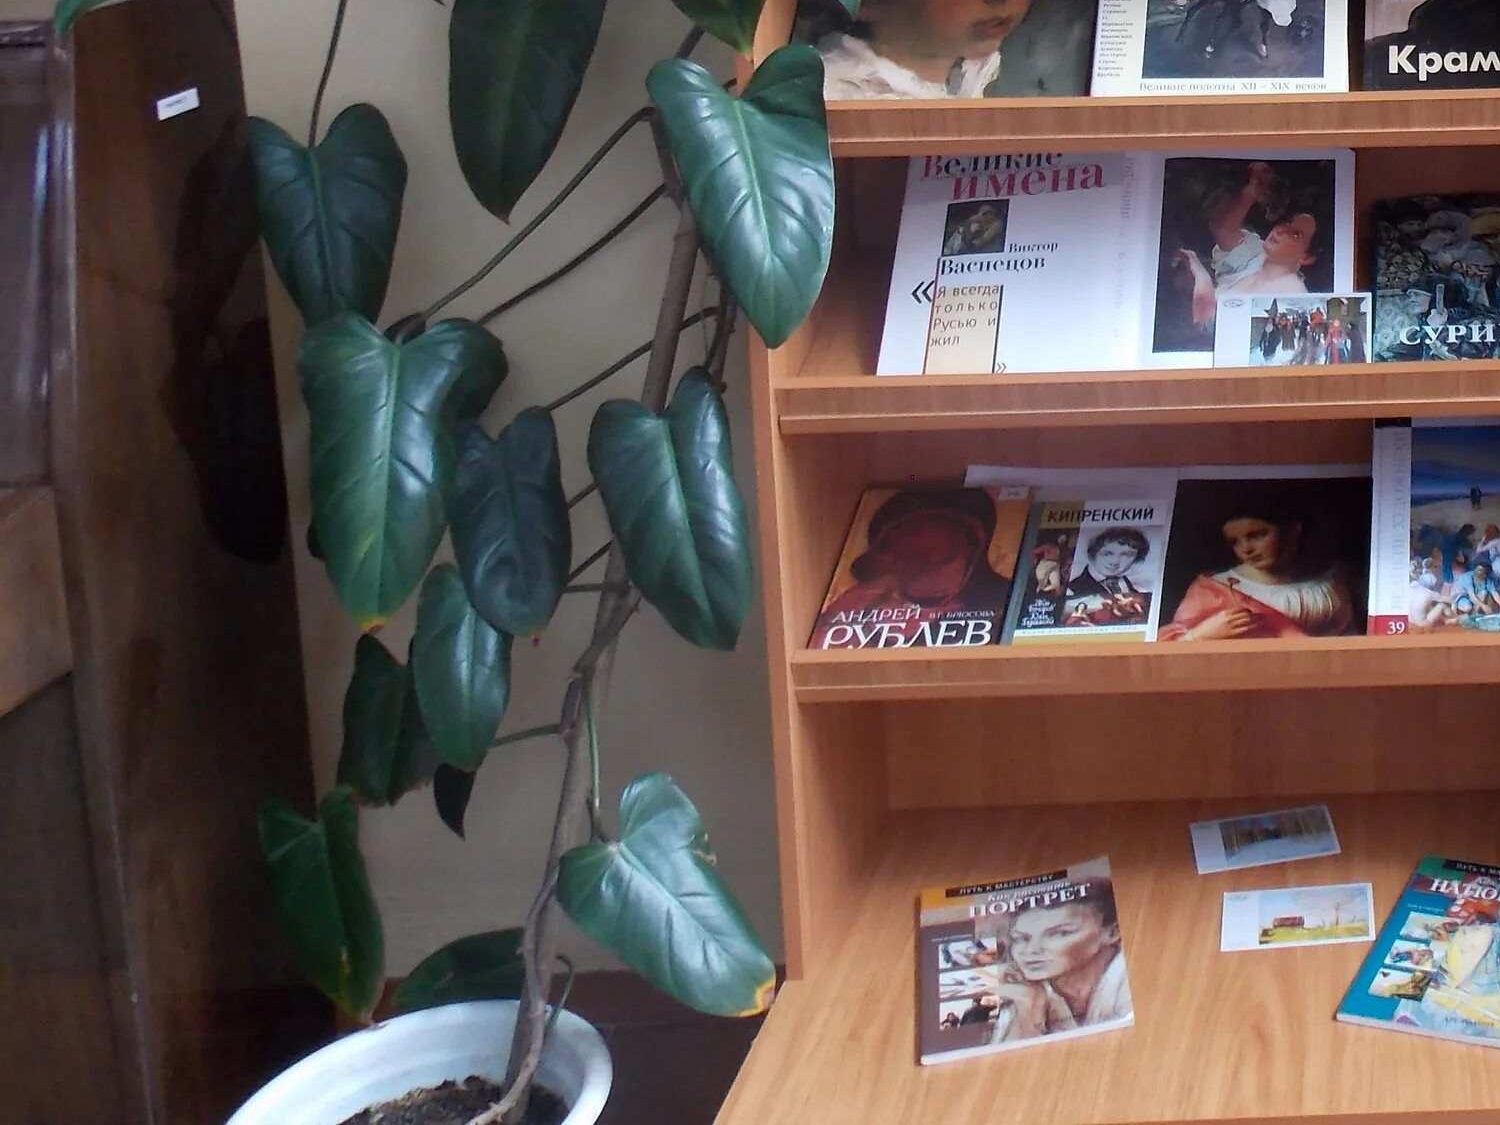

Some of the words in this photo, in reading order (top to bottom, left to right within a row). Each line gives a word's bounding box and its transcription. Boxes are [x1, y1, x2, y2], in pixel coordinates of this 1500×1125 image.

[1139, 81, 1187, 92] Великие
[1189, 81, 1236, 92] полотна
[1270, 80, 1290, 91] XIX
[1295, 81, 1327, 91] веков
[921, 152, 1063, 180] Великие
[953, 163, 1106, 201] имена
[1009, 241, 1059, 254] Виктор
[941, 257, 1046, 276] Васнецов
[937, 286, 947, 298] Я
[952, 284, 1000, 297] всегда
[935, 301, 998, 313] только
[932, 317, 977, 332] Русью
[988, 317, 997, 328] и
[930, 335, 960, 347] жил
[1047, 505, 1154, 523] КИПРЕНСКИЙ
[832, 603, 922, 624] АНДРЕЙ
[822, 620, 993, 650] РУБЛЕВ
[1387, 621, 1405, 635] 39
[968, 883, 1091, 917] ПОРТРЕТ
